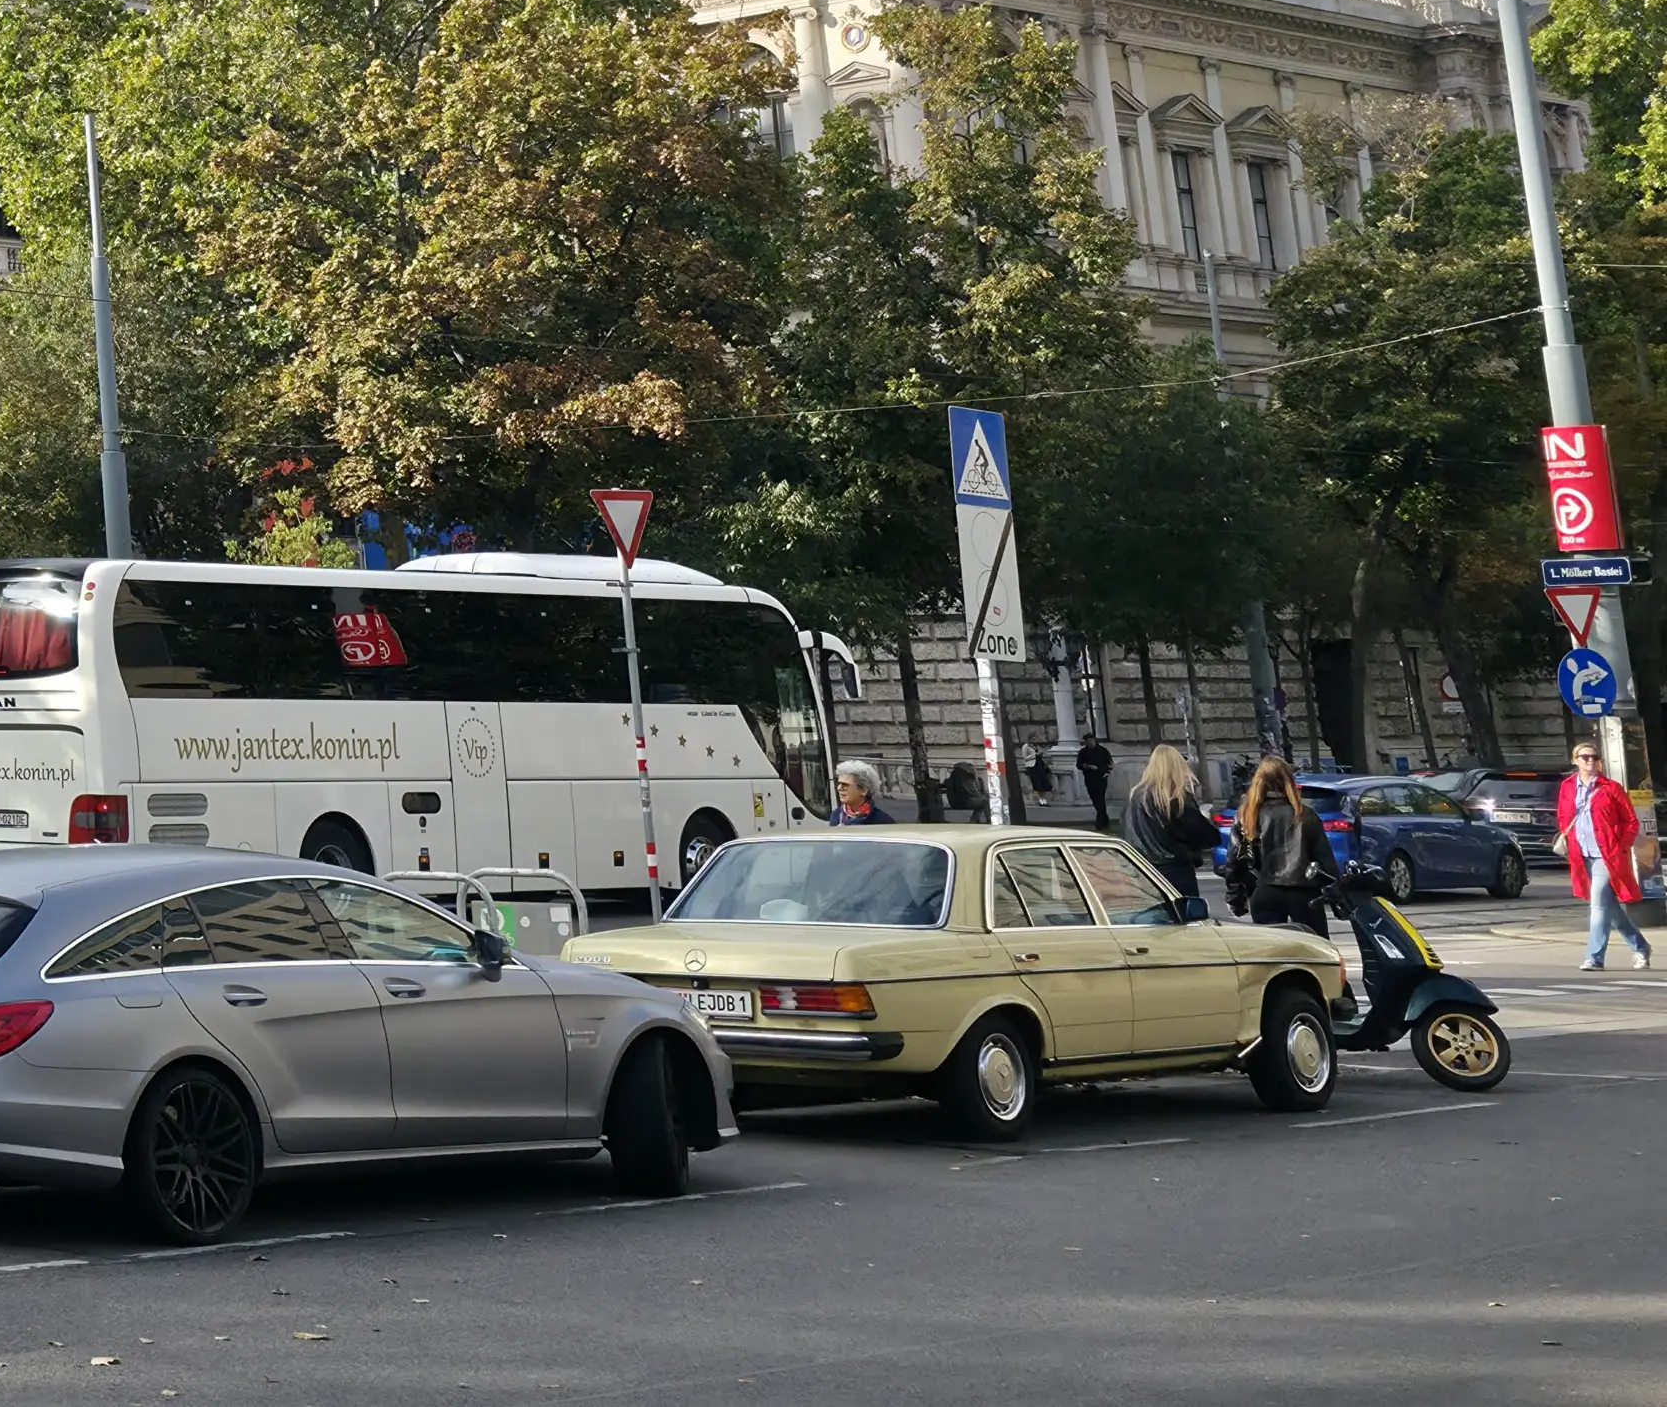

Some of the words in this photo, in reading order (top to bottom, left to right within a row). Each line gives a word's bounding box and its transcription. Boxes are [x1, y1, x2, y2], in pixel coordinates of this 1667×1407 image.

[1561, 568, 1593, 578] Mölker
[1593, 566, 1623, 577] Bastei
[977, 626, 1018, 655] Zone
[174, 721, 401, 773] www.jantex.konin.pl
[463, 738, 488, 768] Vip
